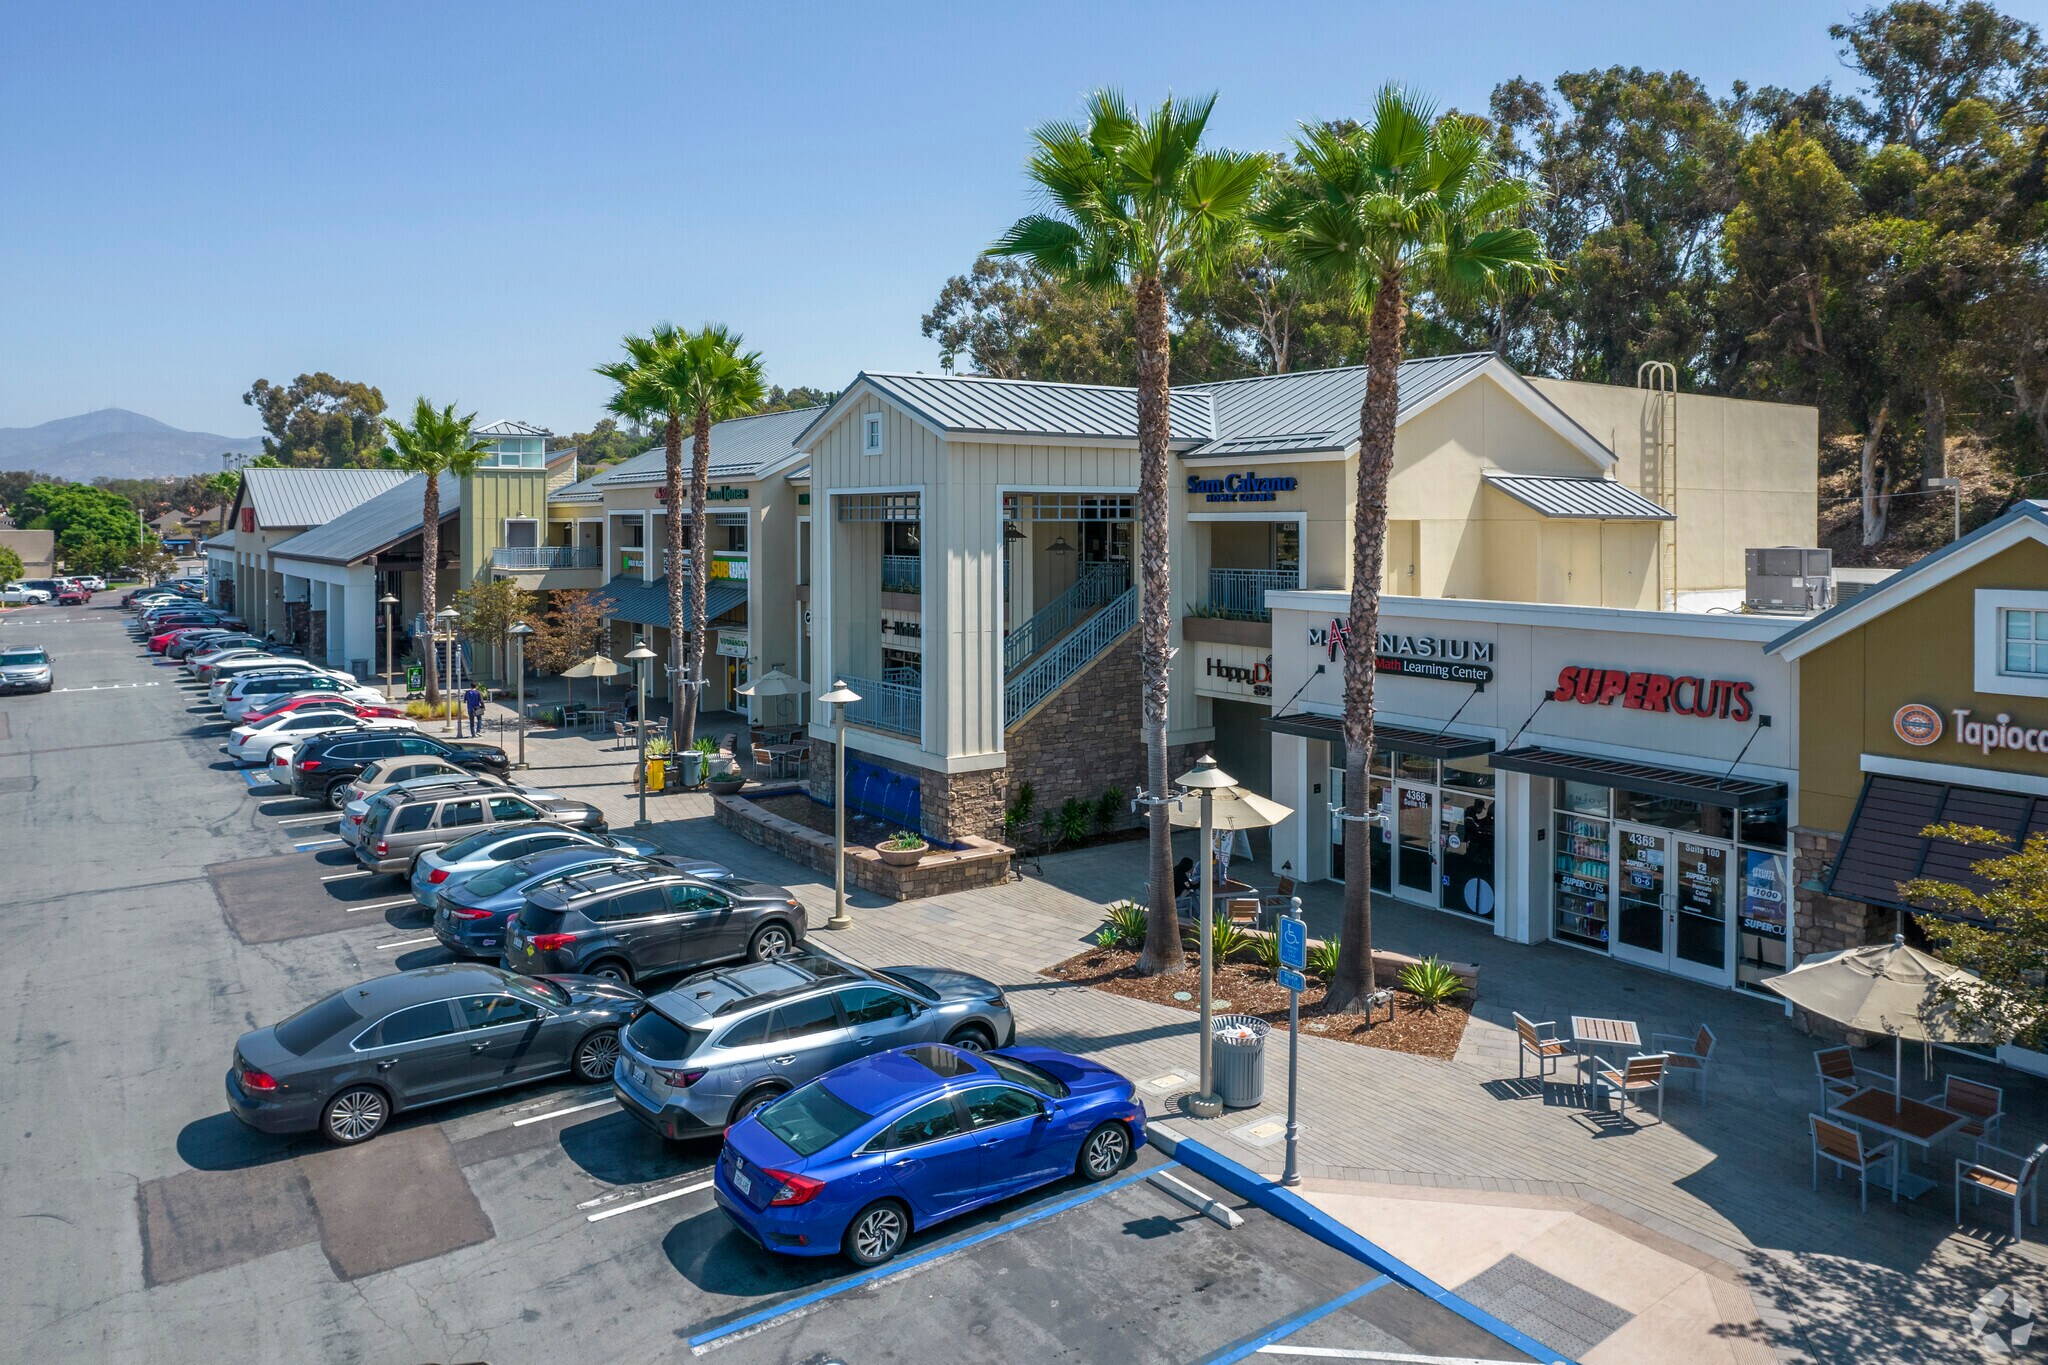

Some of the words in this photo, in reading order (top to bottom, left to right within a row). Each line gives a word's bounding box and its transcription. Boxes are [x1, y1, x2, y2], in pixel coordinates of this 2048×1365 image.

[1188, 475, 1223, 493] Sam
[1225, 472, 1297, 493] Calvano
[1206, 494, 1237, 502] HOME
[1239, 493, 1276, 502] LOANS
[1375, 658, 1401, 671] Math
[1403, 661, 1449, 679] Learning
[1451, 665, 1488, 680] Center
[1554, 665, 1754, 722] SUPERCUTS
[1406, 790, 1426, 802] 4368
[1419, 801, 1428, 809] 101
[1629, 833, 1655, 848] 4368
[1685, 843, 1704, 855] Suite
[1706, 847, 1720, 858] 100
[1626, 859, 1658, 871] SUPERCUTS
[1562, 876, 1604, 893] SUPERCUTS
[1685, 871, 1720, 885] SUPERCUTS
[1695, 890, 1709, 898] Color
[1744, 918, 1787, 935] SUPERCU
